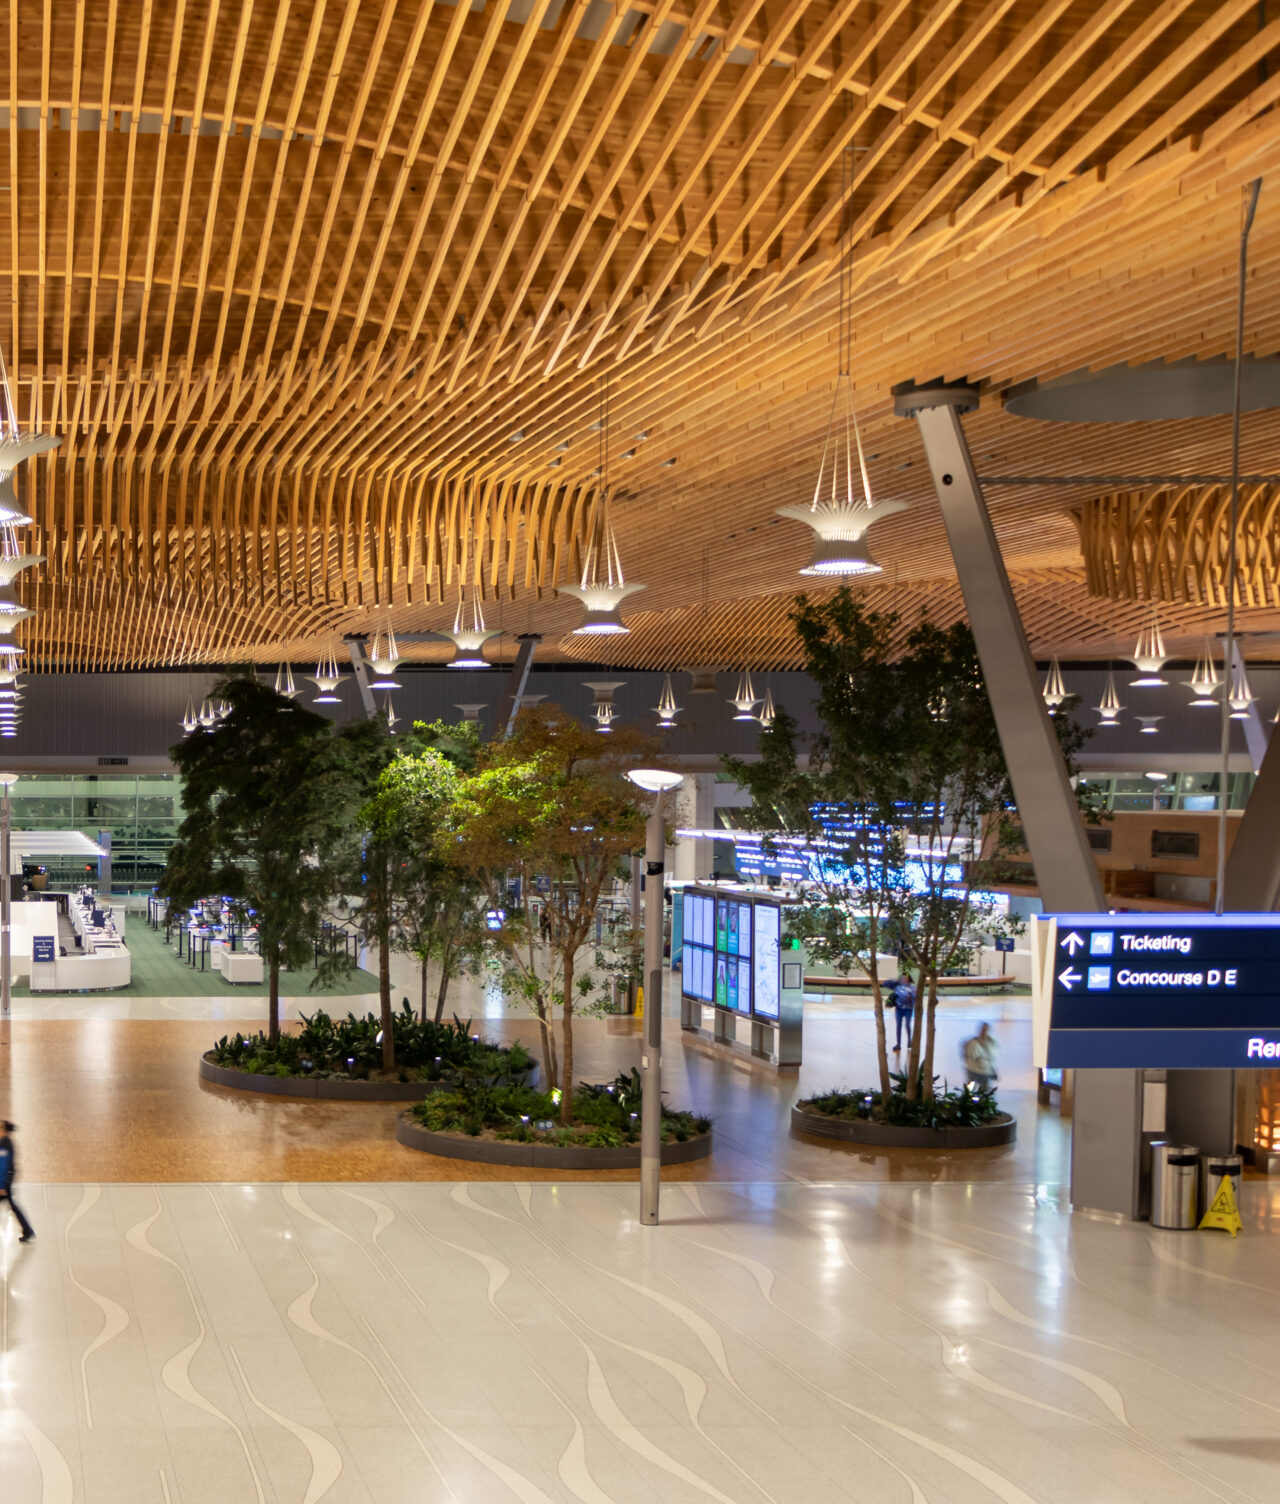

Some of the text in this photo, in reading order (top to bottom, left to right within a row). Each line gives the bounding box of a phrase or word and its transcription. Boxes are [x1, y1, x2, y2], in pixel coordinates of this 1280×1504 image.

[1120, 935, 1192, 953] Ticketing
[1117, 969, 1237, 986] Concourse D E
